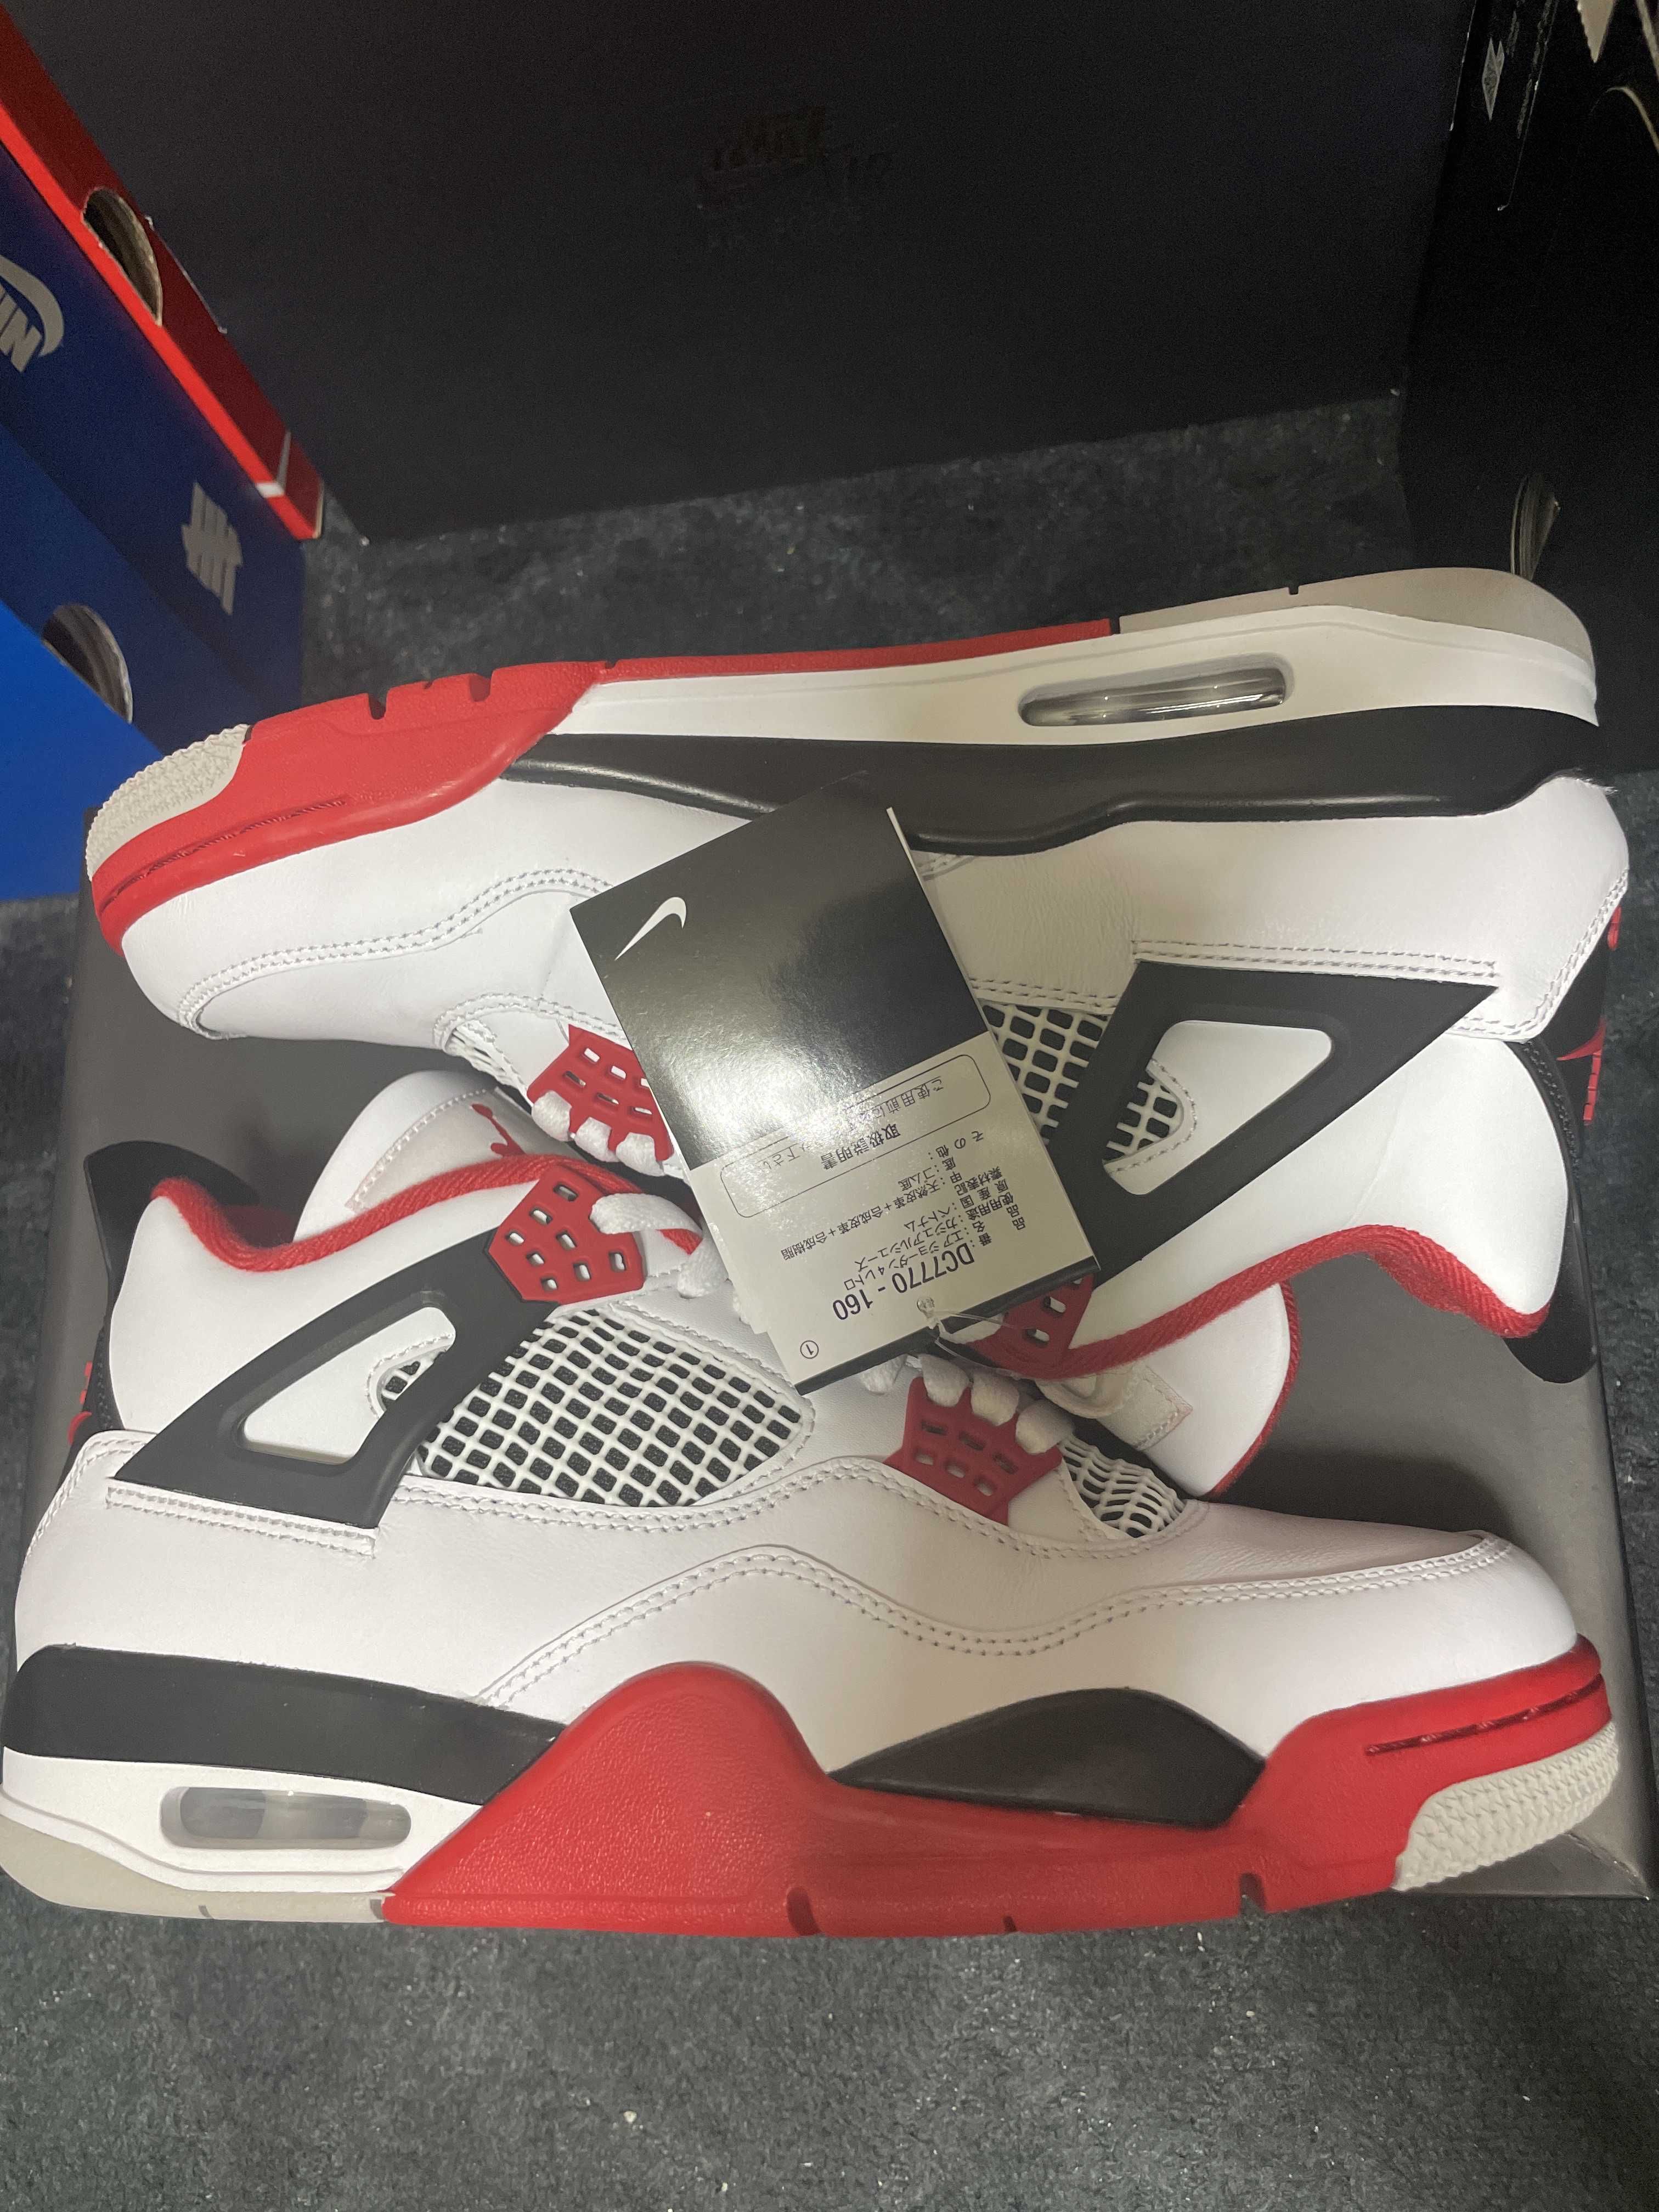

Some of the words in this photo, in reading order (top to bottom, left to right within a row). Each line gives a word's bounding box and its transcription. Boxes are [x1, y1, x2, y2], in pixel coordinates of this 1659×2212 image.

[816, 1120, 902, 1172] 取扱説明書
[953, 1165, 1003, 1196] 素材表記
[843, 1268, 876, 1291] レトロ
[877, 1265, 885, 1276] 4
[891, 1242, 975, 1293] DC7770
[832, 1288, 873, 1321] 160
